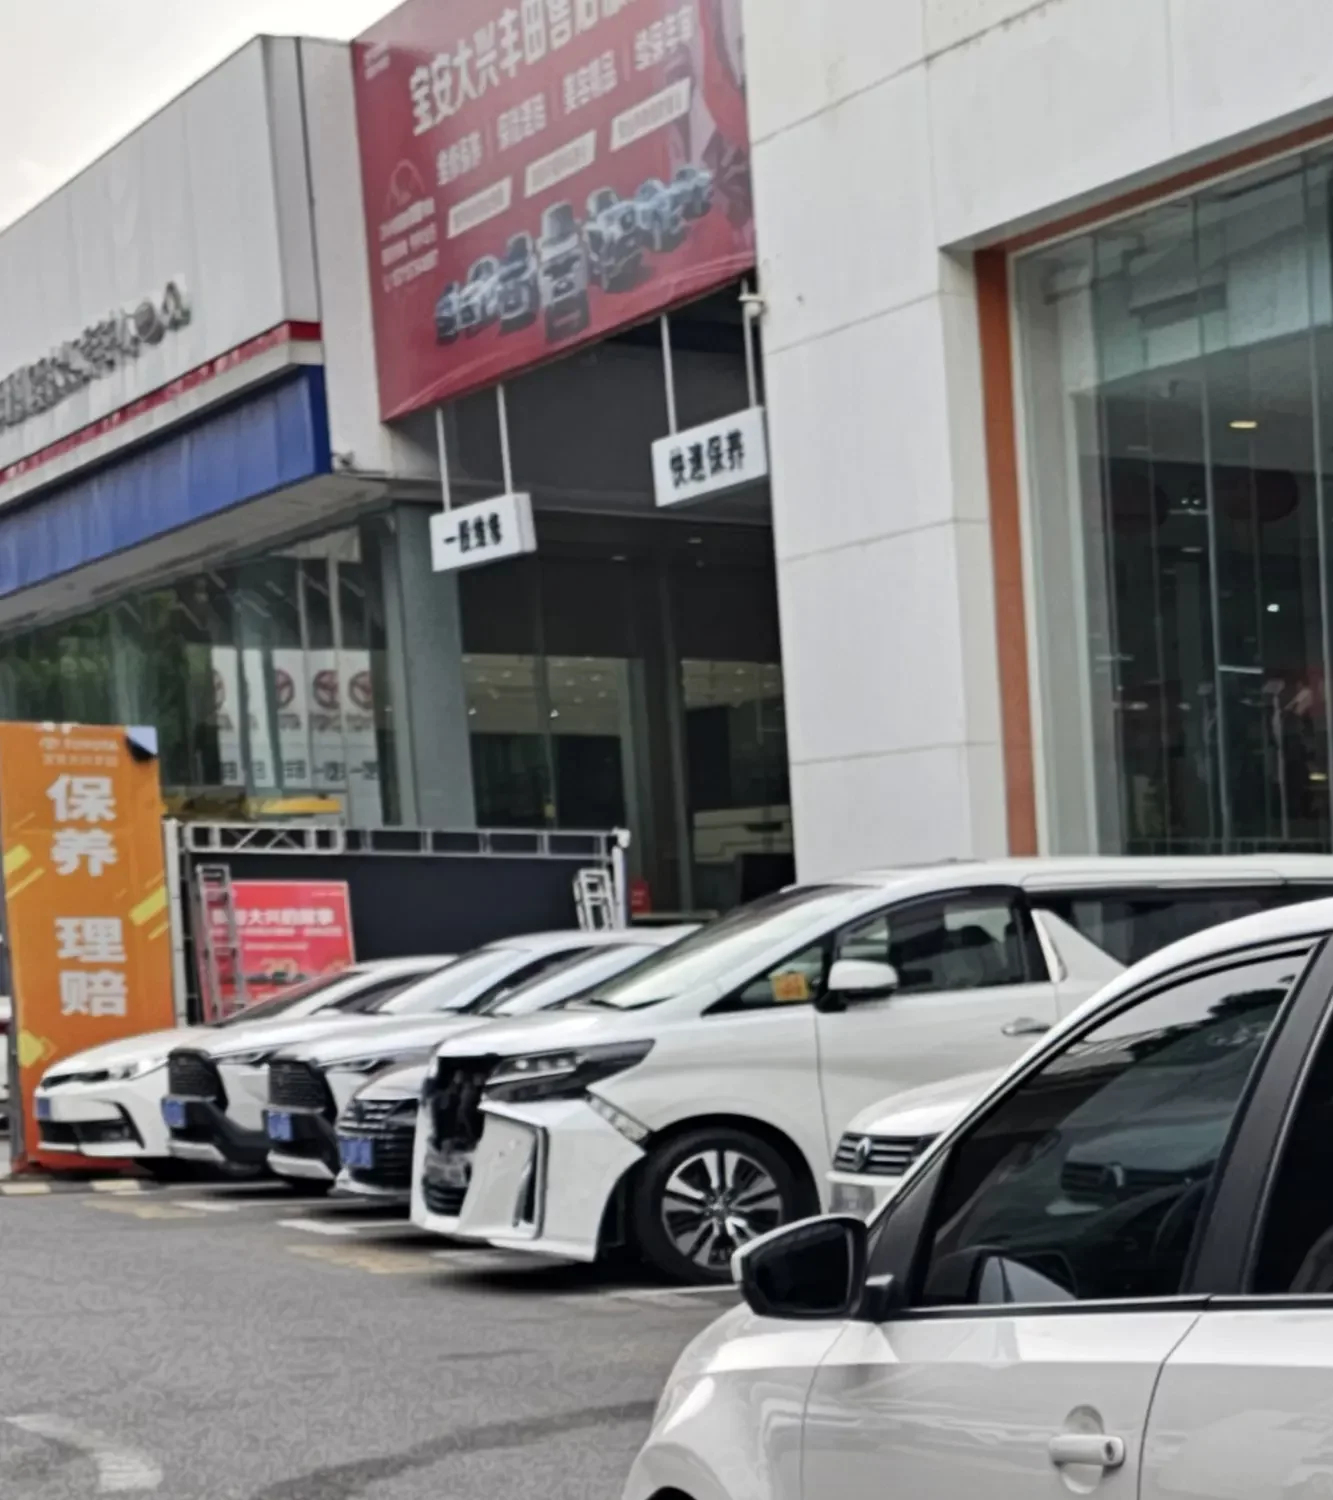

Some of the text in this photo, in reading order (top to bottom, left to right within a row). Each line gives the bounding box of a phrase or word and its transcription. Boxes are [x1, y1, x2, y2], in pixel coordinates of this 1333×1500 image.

[410, 0, 630, 136] 宝安大兴丰田售
[669, 429, 745, 489] 快速保养
[46, 773, 127, 1018] 保养 理赔
